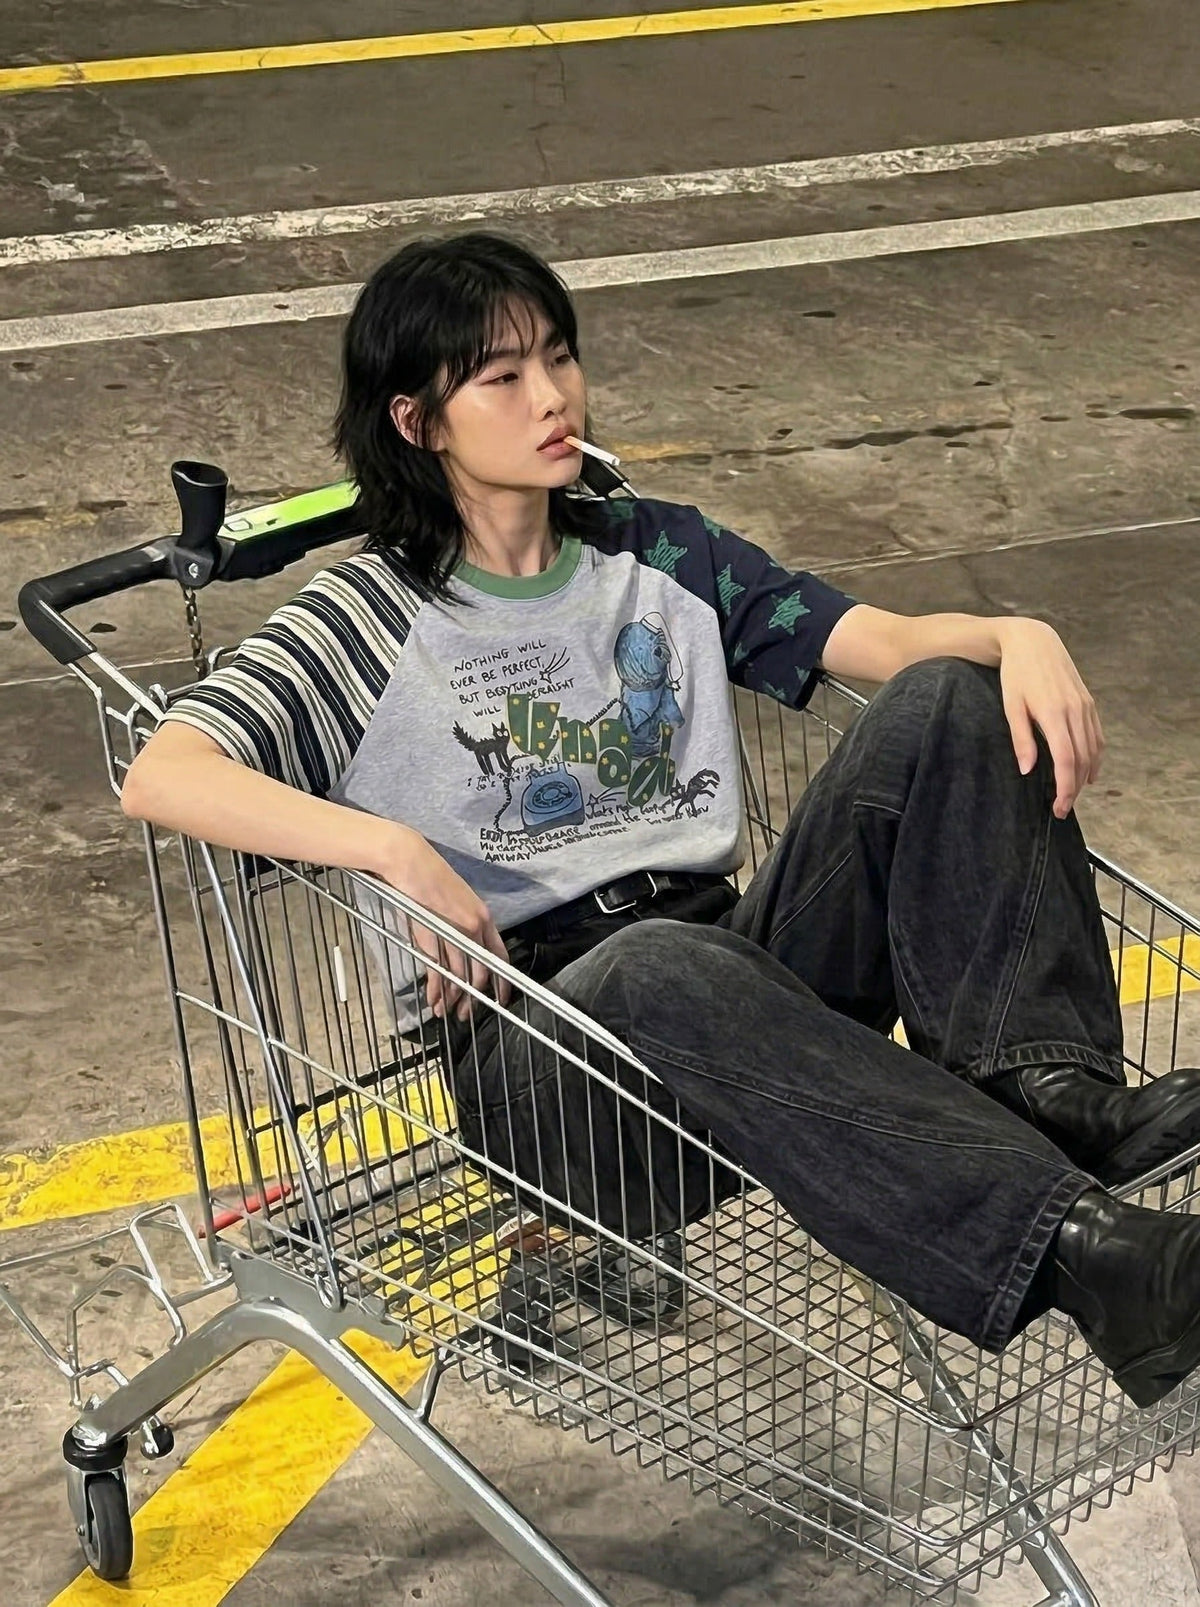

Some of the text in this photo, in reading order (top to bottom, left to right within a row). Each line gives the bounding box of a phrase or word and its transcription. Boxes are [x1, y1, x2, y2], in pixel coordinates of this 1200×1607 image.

[454, 639, 547, 673] NOTHING WILL
[450, 675, 477, 690] EVER
[481, 669, 498, 683] BE
[458, 691, 480, 705] BUT
[473, 705, 502, 718] WILL
